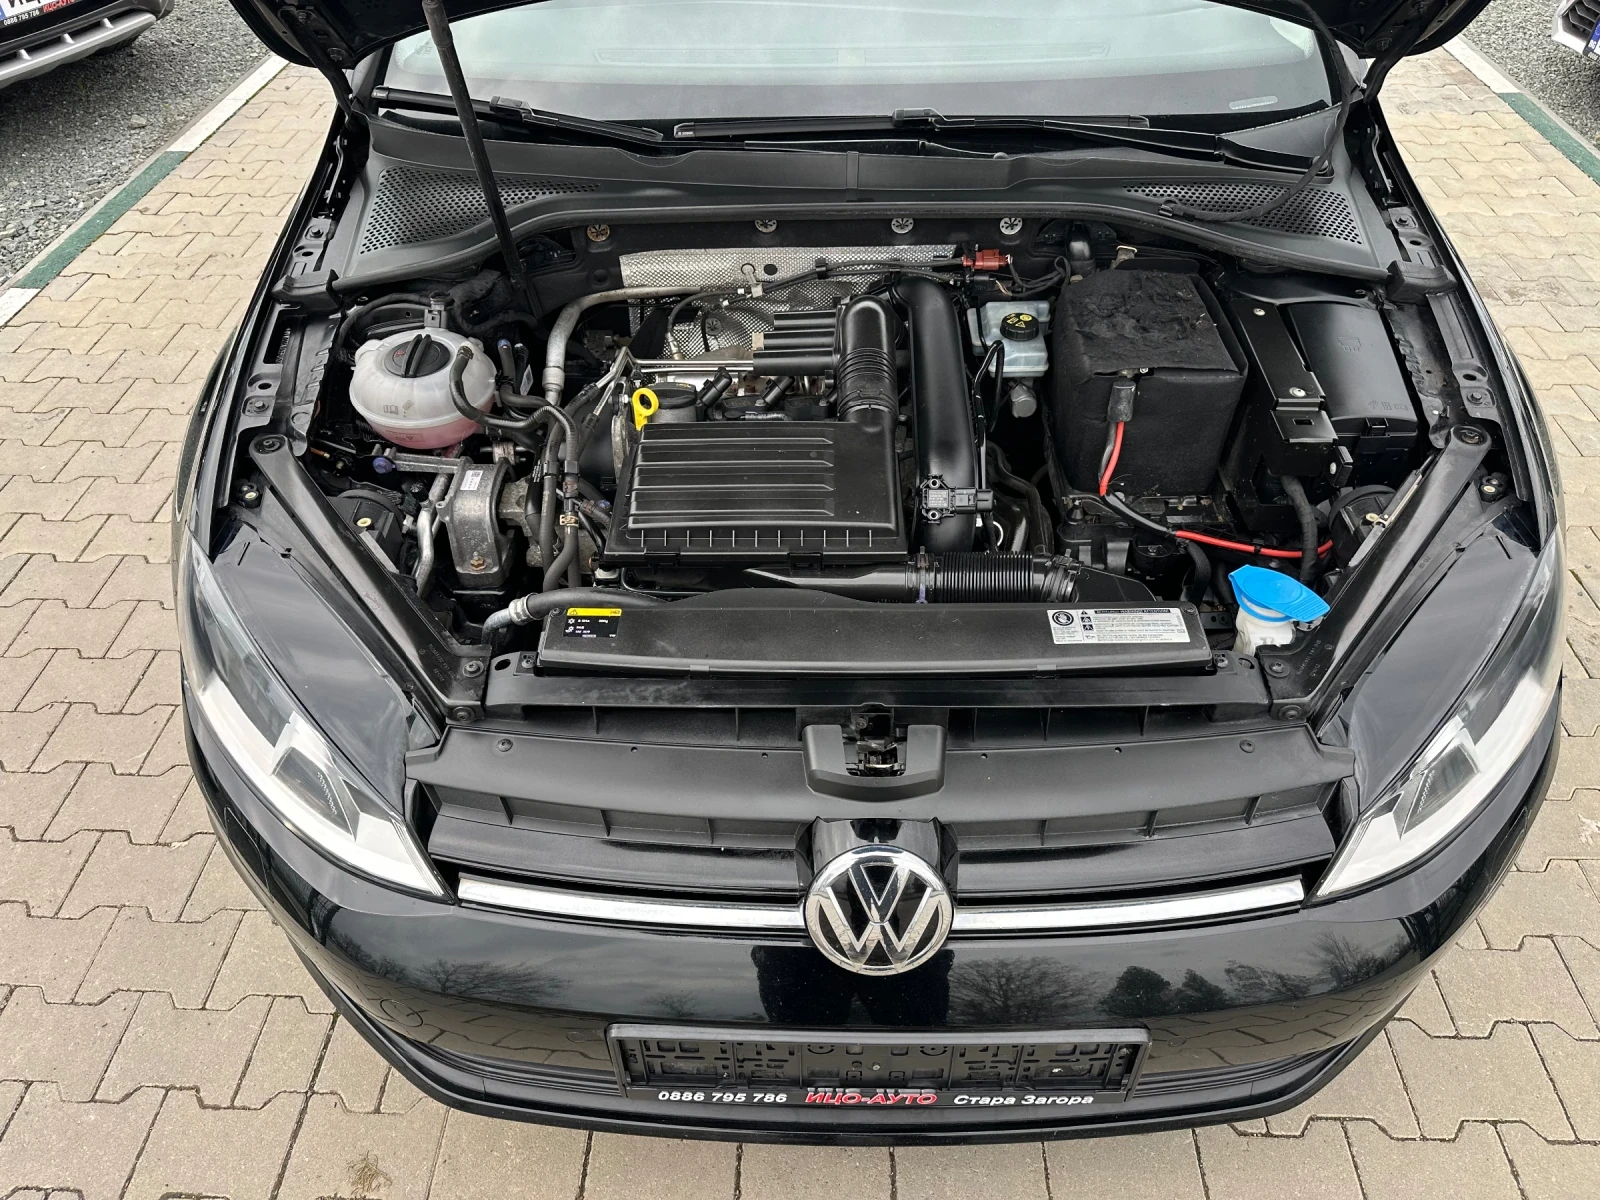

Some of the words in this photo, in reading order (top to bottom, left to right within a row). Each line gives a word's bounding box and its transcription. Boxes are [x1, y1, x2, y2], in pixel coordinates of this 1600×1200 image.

[658, 1090, 705, 1101] 0886
[711, 1091, 747, 1102] 795
[752, 1092, 788, 1103] 786
[805, 1092, 937, 1105] ИЦО-АУТО
[953, 1094, 1017, 1106] Стара
[1021, 1095, 1094, 1105] Загора
